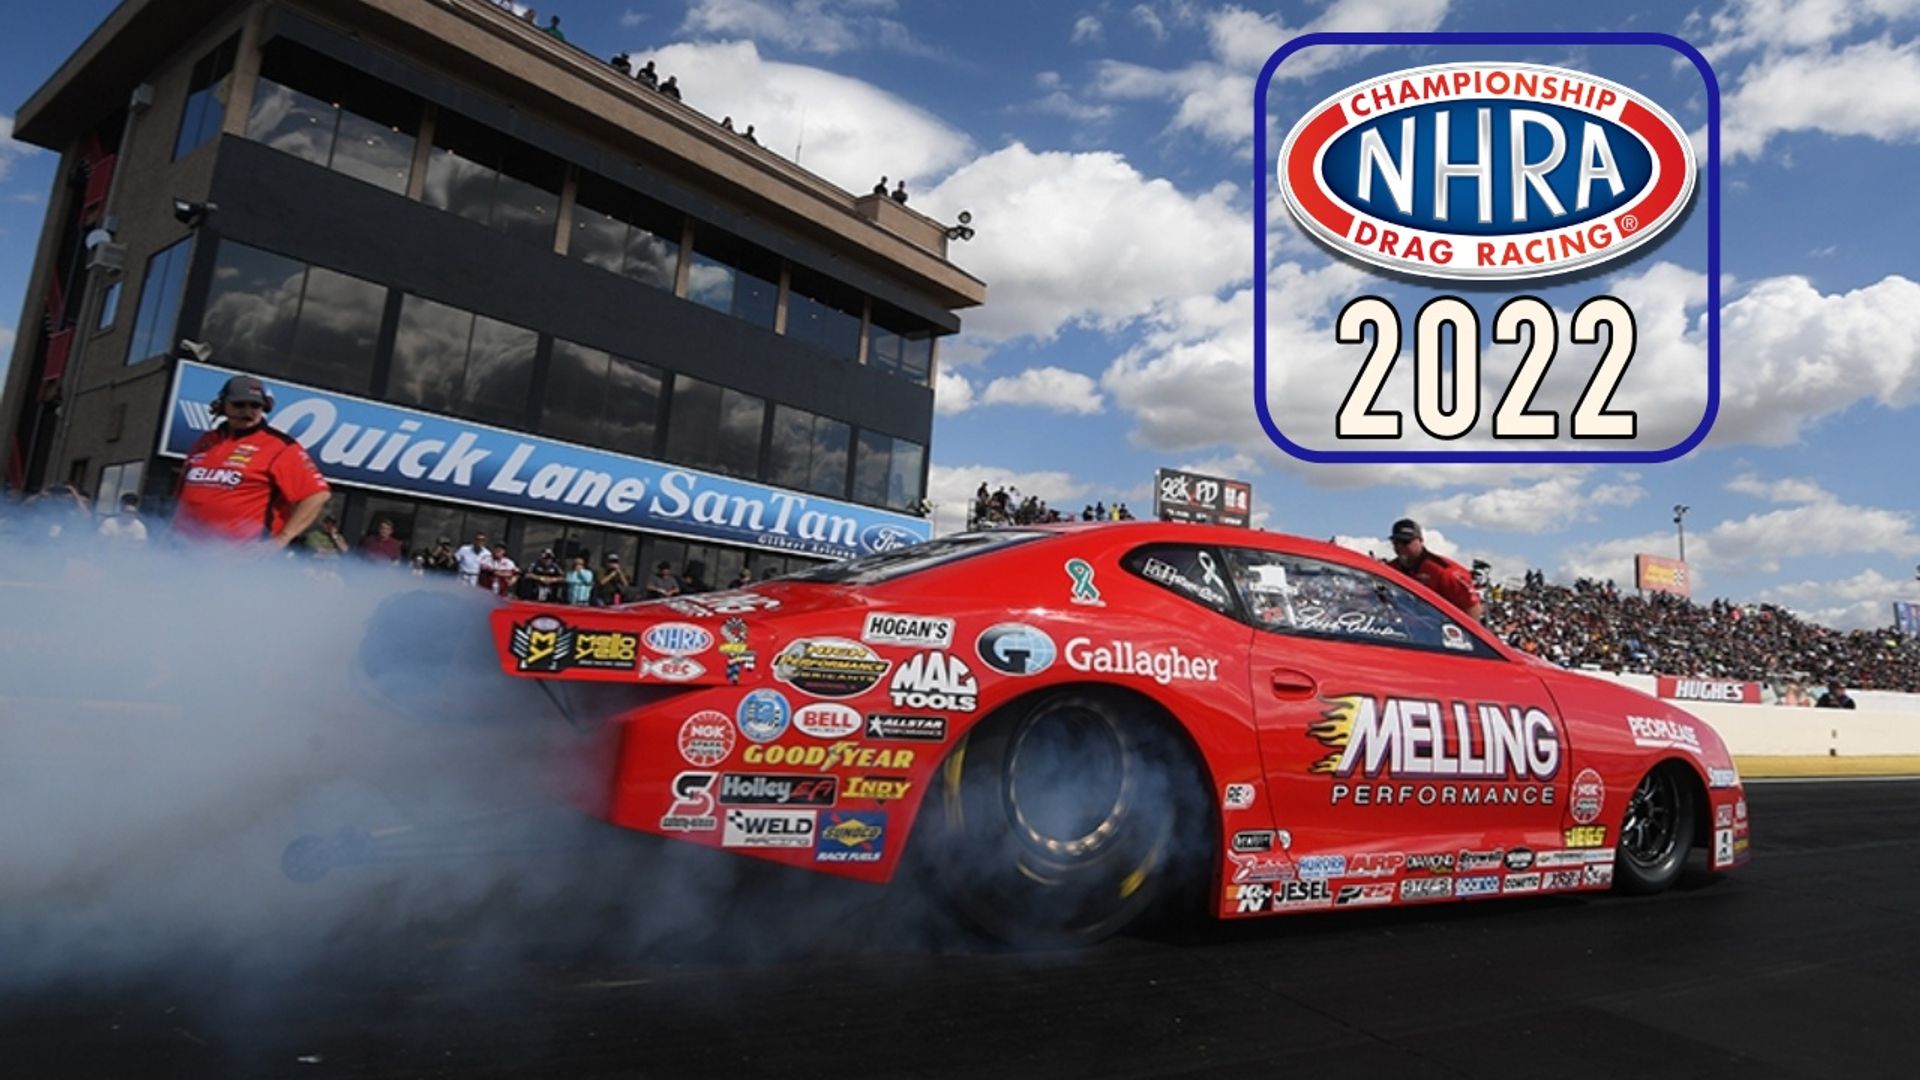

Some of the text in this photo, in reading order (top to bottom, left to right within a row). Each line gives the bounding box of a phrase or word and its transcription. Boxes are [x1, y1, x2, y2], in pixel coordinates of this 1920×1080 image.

[262, 398, 492, 482] Quick
[487, 444, 647, 513] Lane
[869, 616, 949, 640] HOGAN'S
[654, 628, 704, 651] NHRA
[1064, 637, 1219, 685] Gallagher
[890, 651, 978, 695] MAC
[1675, 679, 1744, 700] HUGHES
[889, 692, 977, 711] TOOLS
[803, 711, 853, 727] BELL
[882, 718, 944, 730] ALLSTAR
[690, 724, 724, 739] NGK
[1335, 696, 1560, 780] MELLING
[743, 740, 914, 771] GOODYEAR
[721, 775, 792, 803] Holley
[1331, 785, 1555, 805] PERFORMANCE
[745, 817, 813, 835] WELD
[816, 851, 882, 862] RACE FUELS
[1275, 880, 1330, 902] JESEL
